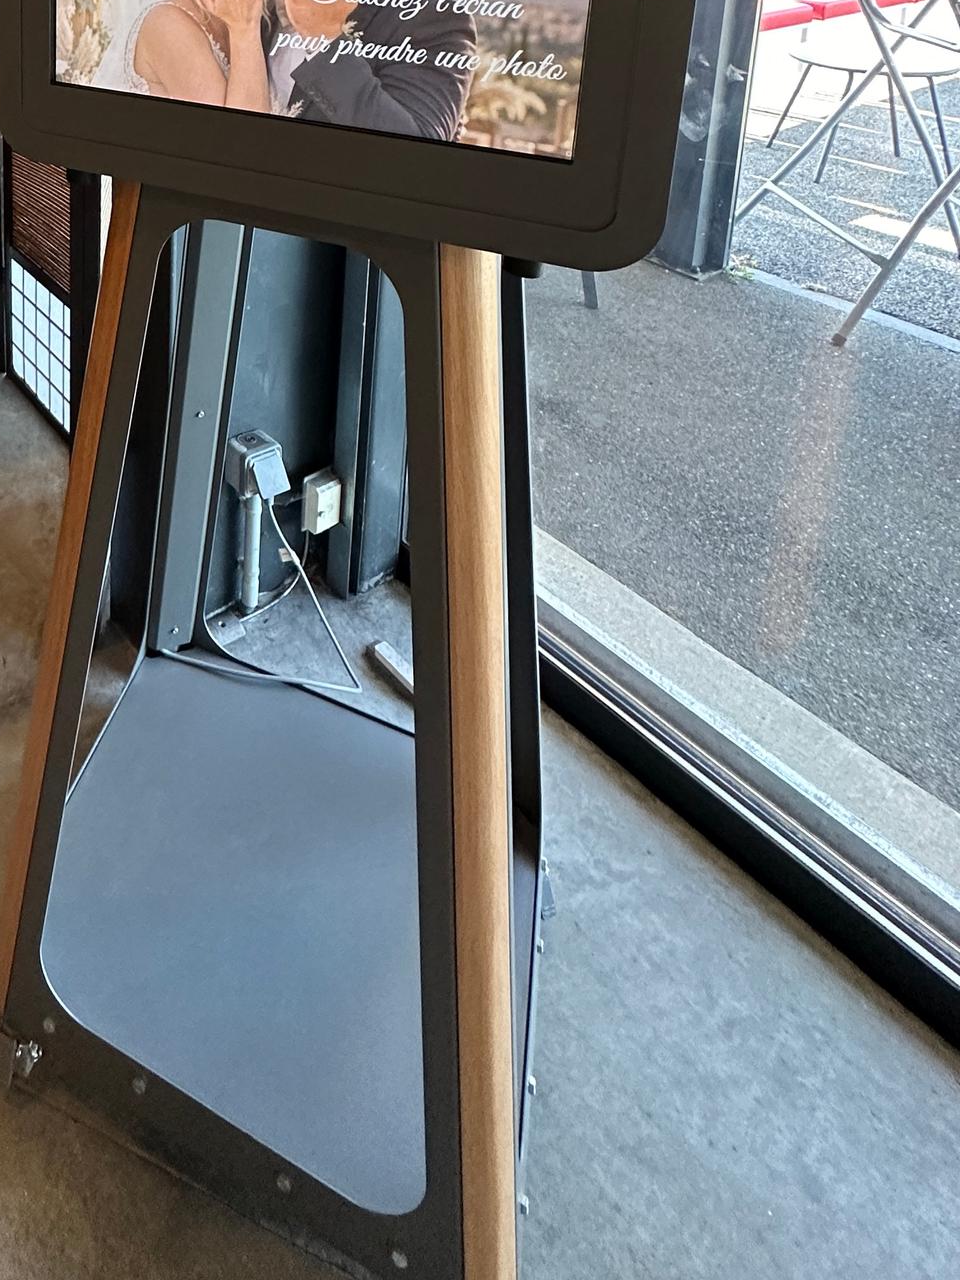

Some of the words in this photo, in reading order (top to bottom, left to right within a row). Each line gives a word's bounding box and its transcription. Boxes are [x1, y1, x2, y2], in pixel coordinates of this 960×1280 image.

[269, 32, 331, 56] pour
[329, 36, 428, 65] prendre
[434, 50, 482, 71] une
[480, 49, 568, 82] photo
